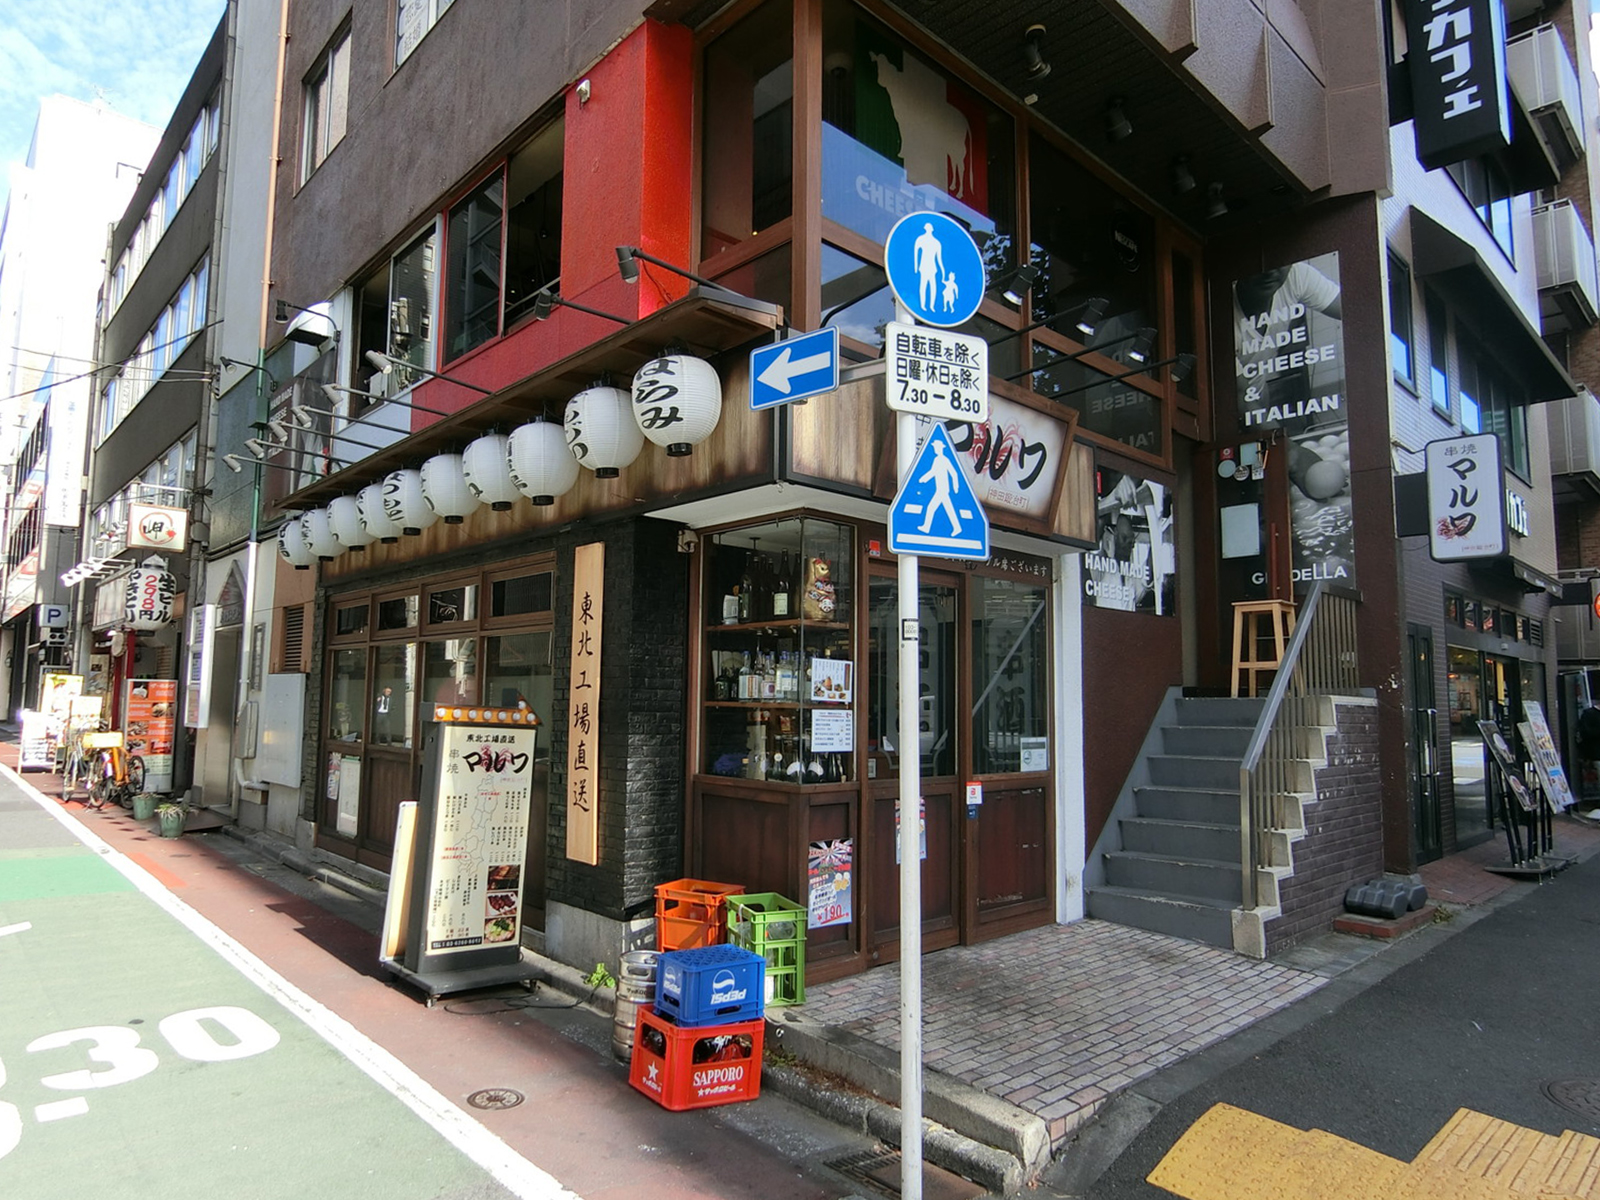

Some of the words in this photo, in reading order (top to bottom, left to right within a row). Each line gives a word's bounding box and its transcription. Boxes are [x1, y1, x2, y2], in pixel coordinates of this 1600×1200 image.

[1420, 0, 1482, 119] カフェ
[1240, 303, 1305, 333] HAND
[897, 332, 980, 366] 自転車を除く
[1242, 326, 1307, 355] MADE
[1242, 344, 1336, 379] CHEESE
[1244, 386, 1260, 402] &
[1244, 394, 1340, 426] ITALIAN
[1444, 443, 1478, 456] 串焼
[1446, 458, 1478, 536] マルワ
[1085, 552, 1117, 574] HAND
[1120, 560, 1150, 581] MADE
[125, 570, 142, 622] やきとり
[139, 575, 157, 621] 298円
[153, 573, 175, 623] 生ビール
[1085, 579, 1131, 602] CHEESE
[48, 608, 61, 623] P
[573, 591, 595, 812] 東北工場直送
[462, 750, 529, 774] マルワ
[692, 1065, 744, 1087] SAPPORO
